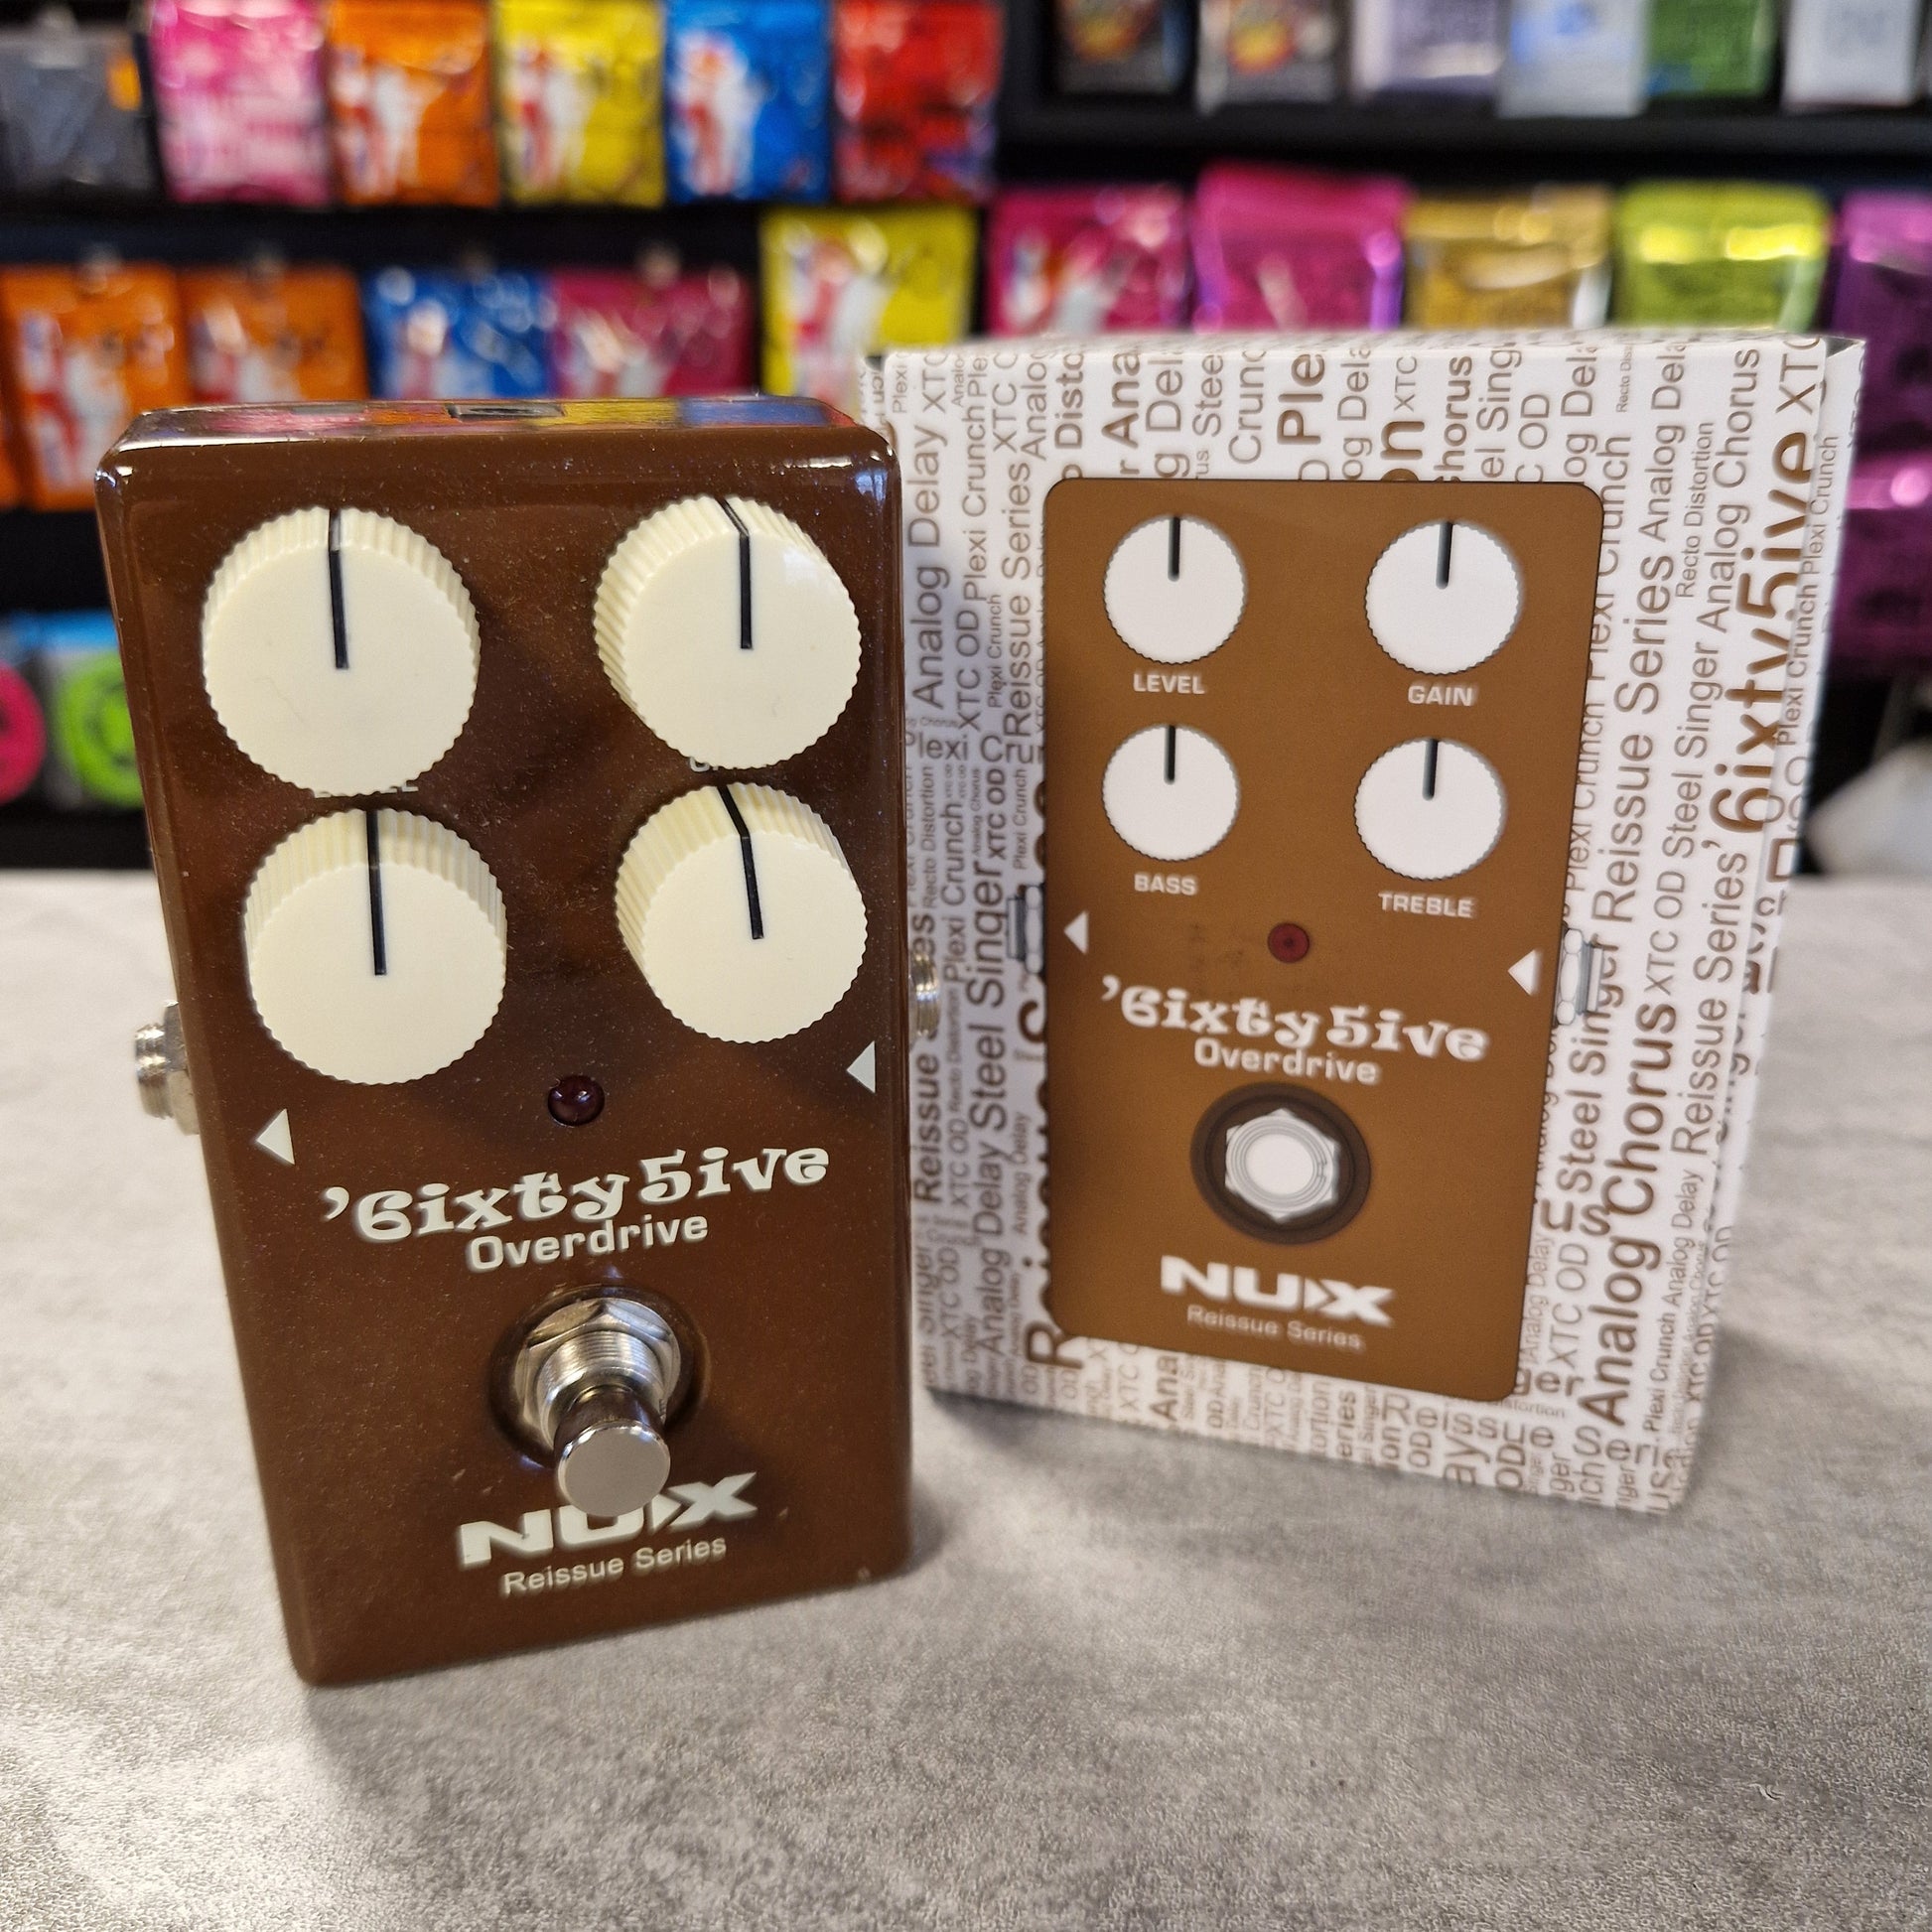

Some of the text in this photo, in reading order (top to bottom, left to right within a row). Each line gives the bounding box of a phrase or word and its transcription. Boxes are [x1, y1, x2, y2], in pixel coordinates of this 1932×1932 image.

[991, 382, 1018, 454] XTC
[1394, 355, 1419, 412] XTC
[1433, 355, 1473, 482] horus
[1517, 393, 1551, 451] OD
[1614, 375, 1631, 413] Recto
[907, 425, 948, 548] Delay
[960, 405, 986, 517] Crunch
[1638, 424, 1687, 544] Analog
[1808, 435, 1839, 517] Crunch
[1001, 463, 1032, 581] Series
[1675, 421, 1715, 599] Recto Distortion
[1801, 522, 1827, 576] Plexi
[962, 529, 988, 601] Plexi
[910, 566, 951, 710] Analog
[956, 609, 982, 733] XTC OD
[987, 594, 1005, 709] Plexi Crunch
[1002, 595, 1033, 739] Reissue
[1613, 554, 1676, 715] Series
[1643, 348, 1760, 997] XTC OD Steel Singer Analog Chorus
[1787, 585, 1823, 680] Crunch
[1133, 673, 1205, 695] LEVEL
[1408, 685, 1477, 707] GAIN
[1776, 687, 1804, 747] Plexi
[919, 765, 938, 852] Distortion
[987, 768, 1007, 861] XTC OD
[1011, 768, 1029, 871] Plexi Crunch
[1590, 734, 1653, 923] Reissue
[938, 802, 967, 983] Plexi Crunch
[1134, 873, 1198, 896] BASS
[1378, 891, 1476, 918] TREBLE
[1693, 852, 1748, 983] Series
[966, 861, 1009, 1008] Singer
[968, 1023, 1007, 1132] Steel
[1193, 1035, 1383, 1085] Overdrive
[1671, 998, 1728, 1155] Reissue
[910, 1053, 943, 1203] Reissue
[948, 1118, 969, 1155] OD
[1556, 1090, 1603, 1193] Steel
[948, 1156, 971, 1210] XTC
[973, 1141, 1013, 1237] Delay
[1577, 1003, 1678, 1427] Analog Chorus
[1671, 1169, 1705, 1227] Delay
[467, 1213, 712, 1275] Overdrive
[1661, 1237, 1694, 1308] Analog
[978, 1247, 1011, 1358] Analog
[1161, 1254, 1397, 1329] NUX
[1186, 1303, 1365, 1352] Reissue Series
[1547, 1242, 1588, 1370] XTC OD
[1649, 1311, 1677, 1382] Crunch
[1381, 1391, 1556, 1450] Reissue
[1408, 1432, 1433, 1468] OD
[1641, 1389, 1667, 1432] Plexi
[1494, 1443, 1527, 1490] OD
[460, 1471, 761, 1566] NUX
[501, 1535, 731, 1597] Reissue Series
